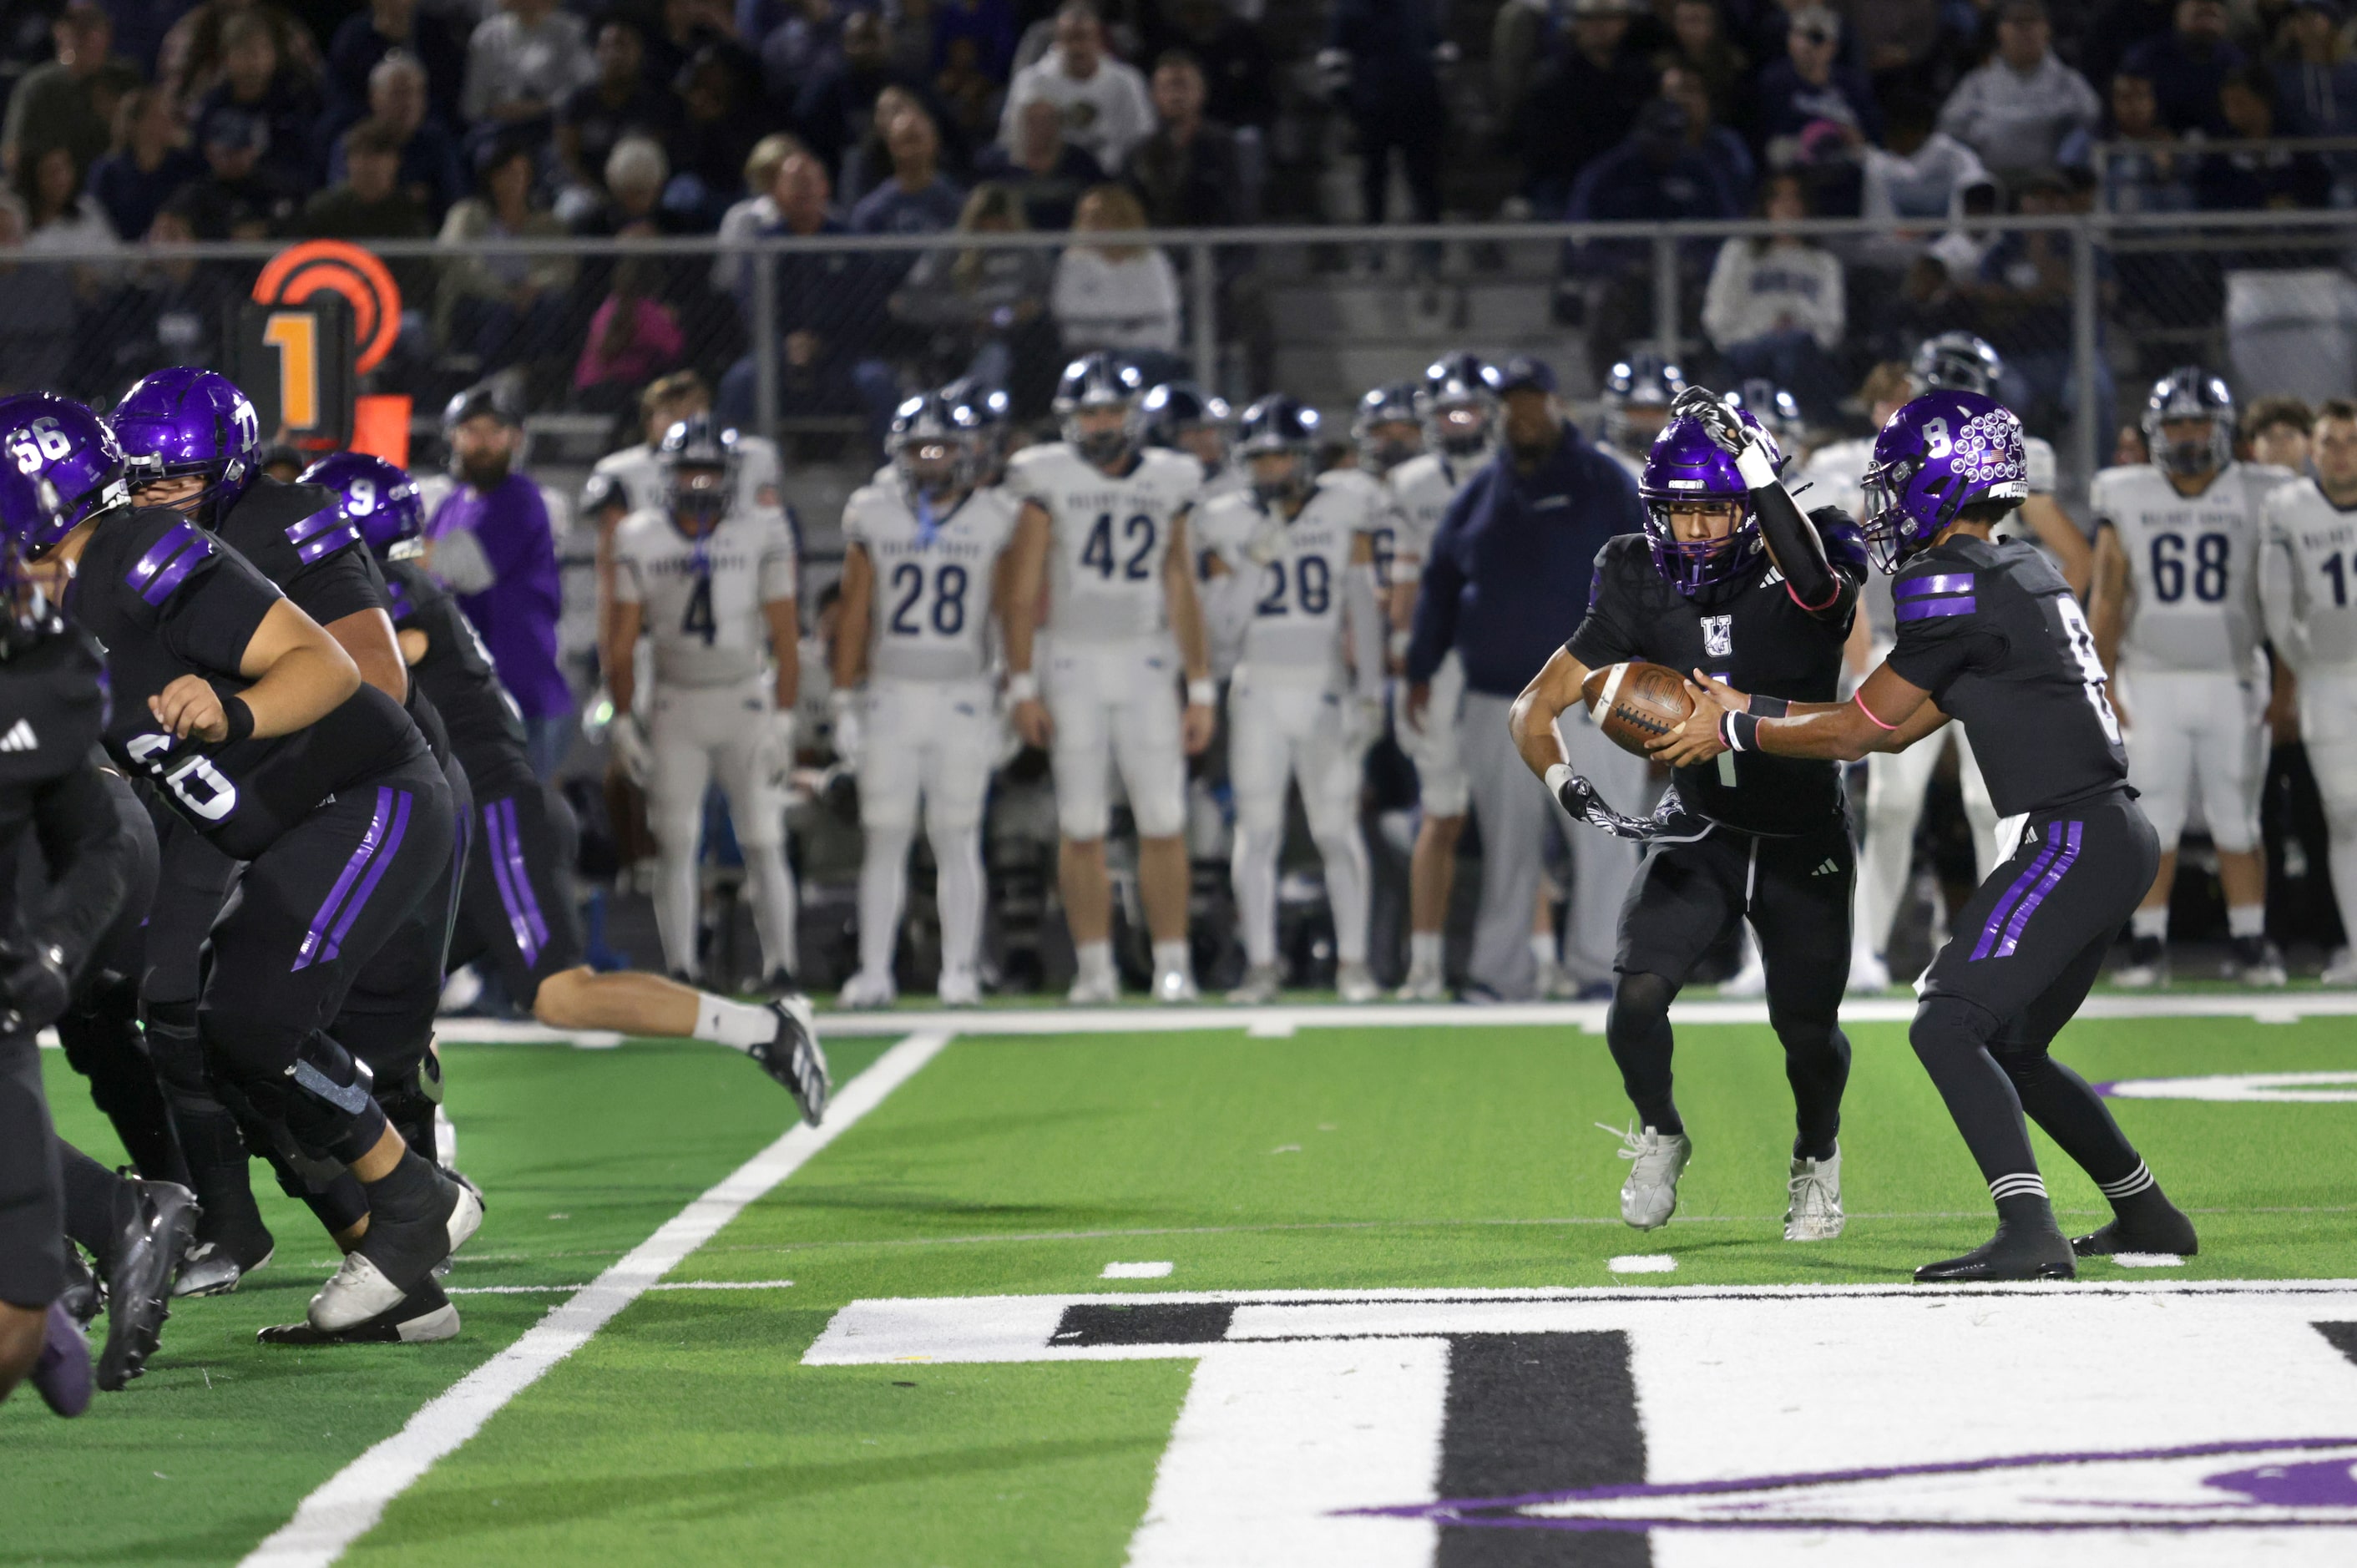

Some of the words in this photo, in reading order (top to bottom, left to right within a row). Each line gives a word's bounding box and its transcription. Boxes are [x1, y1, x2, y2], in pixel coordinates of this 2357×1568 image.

[263, 313, 321, 429] 1
[1922, 417, 1952, 459] 8
[348, 478, 376, 516] 9
[1081, 511, 1156, 580] 42
[2149, 532, 2228, 603] 68
[680, 575, 718, 645] 4
[891, 562, 968, 636] 28
